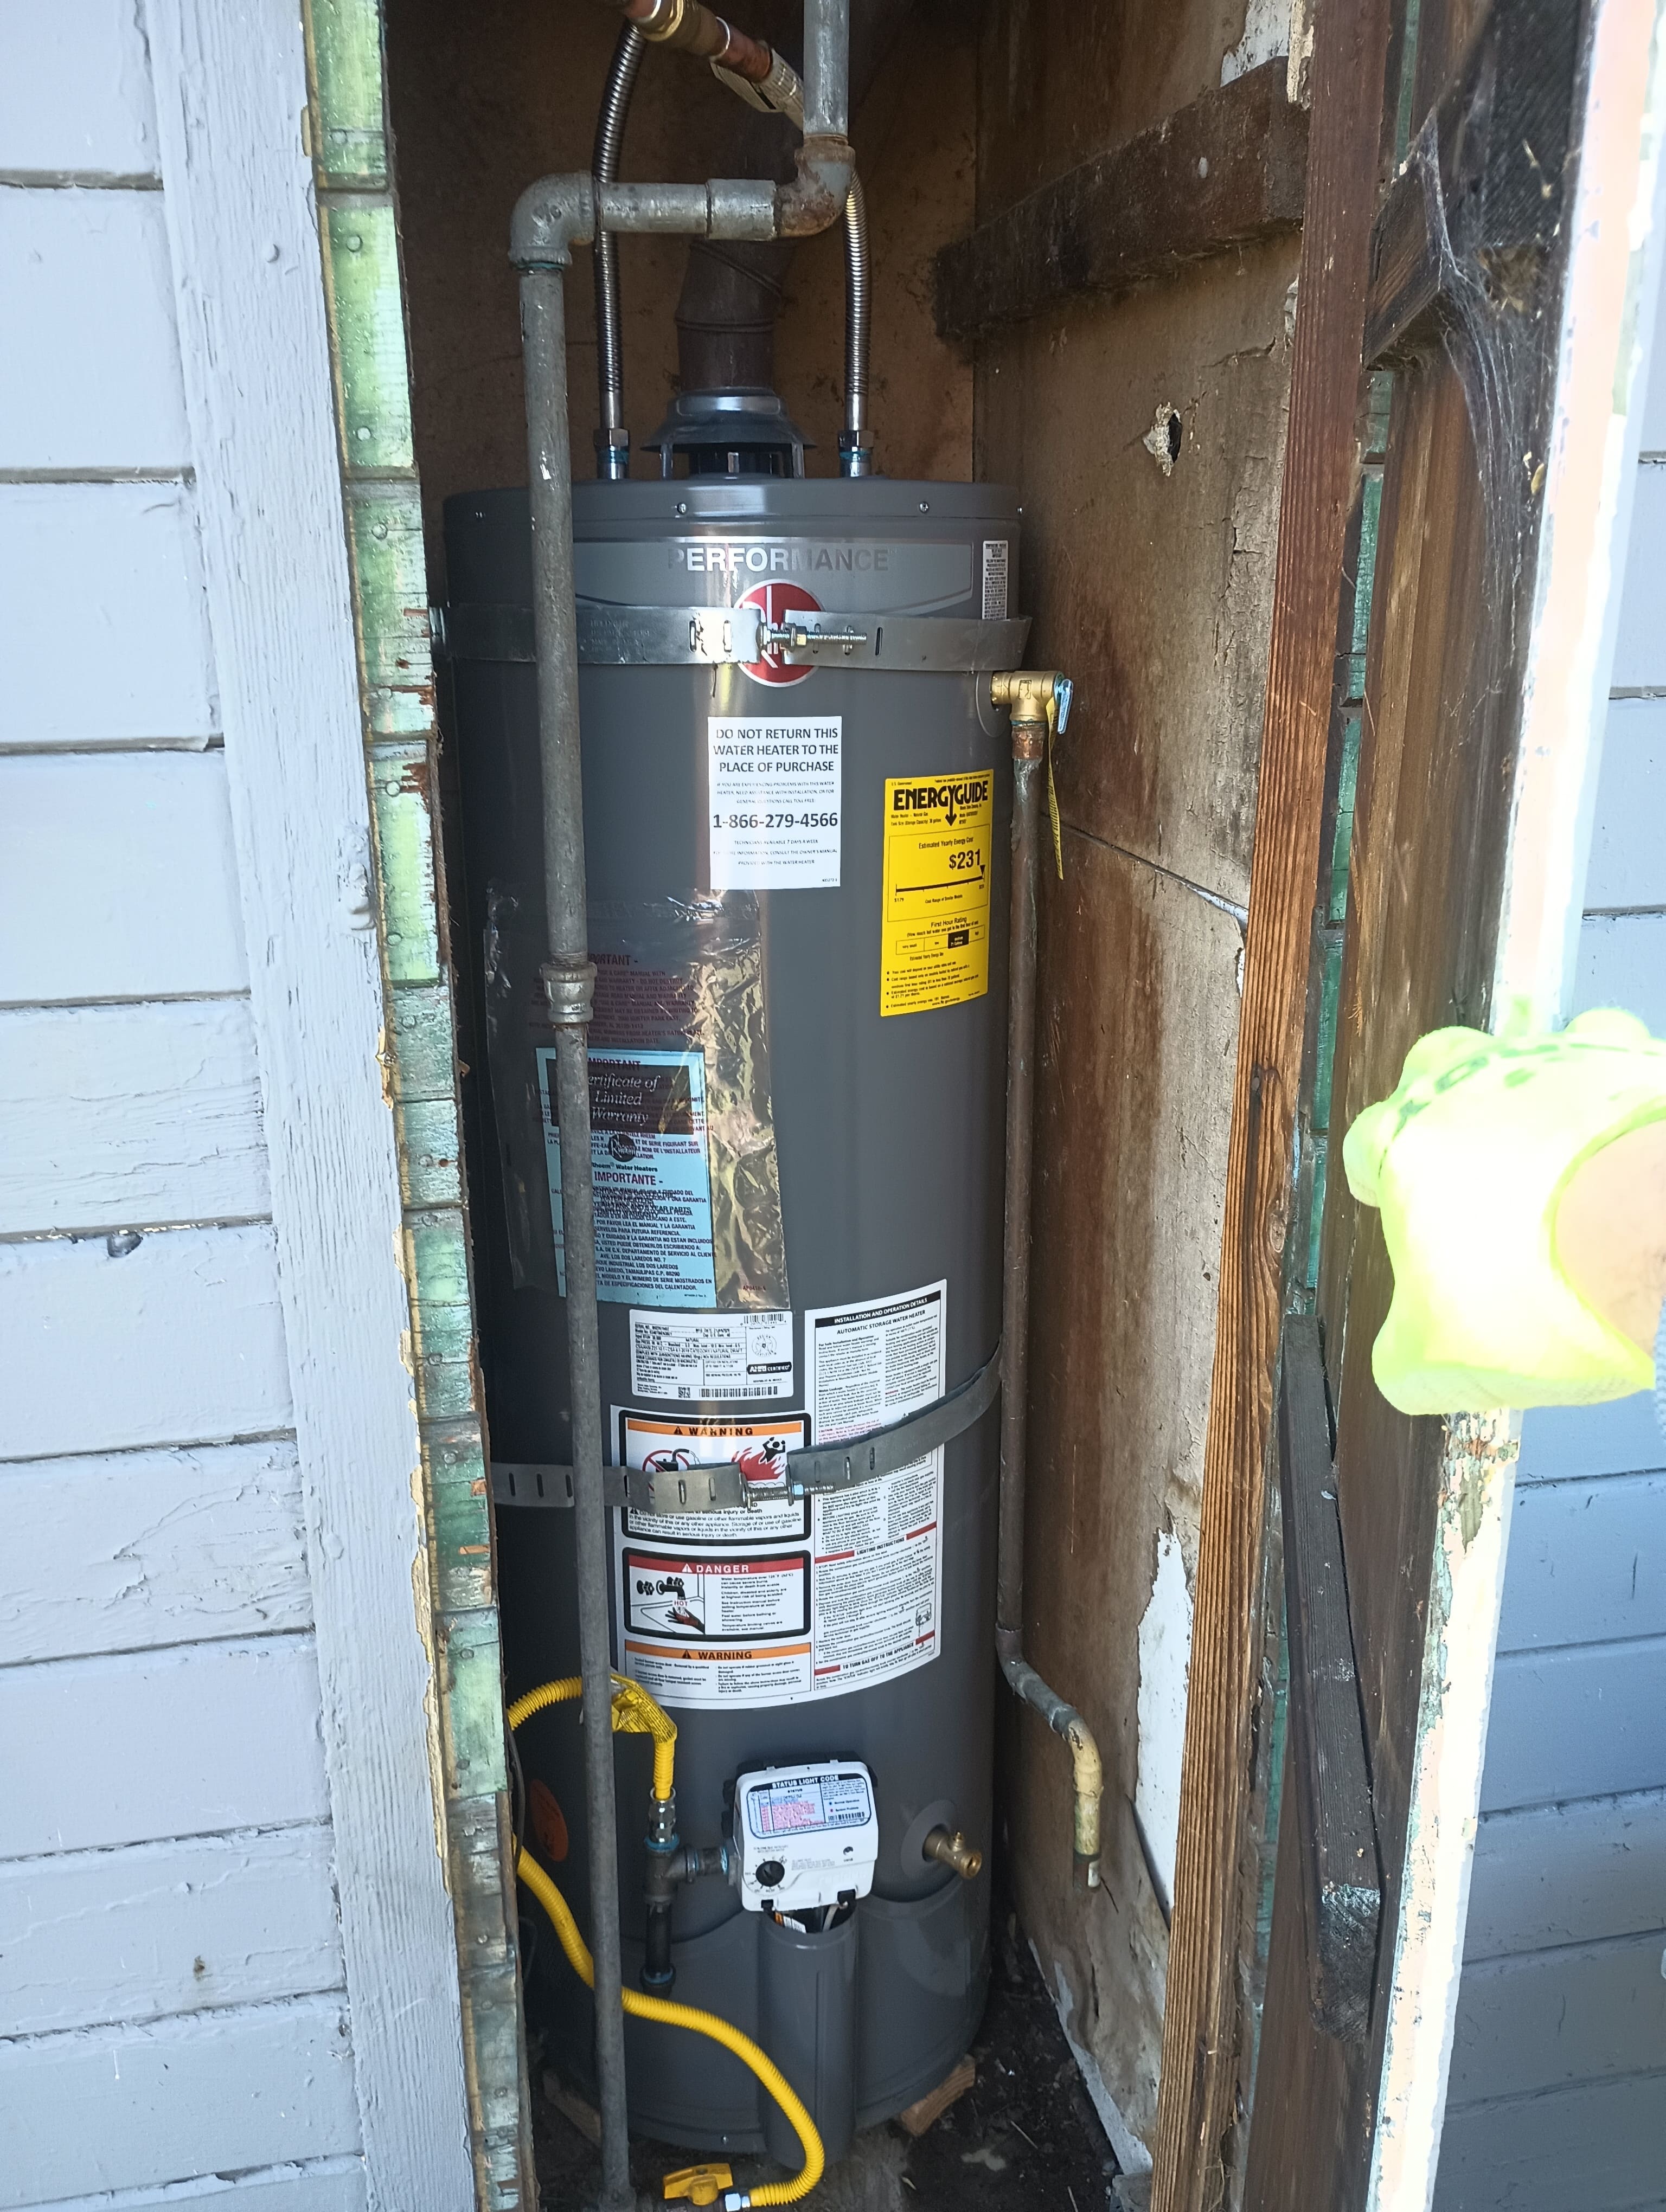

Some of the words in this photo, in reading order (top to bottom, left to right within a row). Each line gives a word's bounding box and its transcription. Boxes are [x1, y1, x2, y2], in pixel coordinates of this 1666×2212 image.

[668, 547, 888, 571] PERFORMANCE
[716, 729, 733, 738] DO
[738, 729, 762, 738] NOT
[766, 729, 811, 738] RETURN
[814, 728, 838, 738] THIS
[713, 745, 754, 755] WATER
[757, 745, 799, 755] HEATER
[802, 745, 816, 754] TO
[819, 744, 838, 754] THE
[720, 762, 754, 772] PLACE
[758, 762, 773, 772] OF
[776, 761, 834, 771] PURCHASE
[894, 781, 988, 811] ENERGYGUIDE
[713, 813, 838, 828] 1-866-279-4566
[949, 848, 981, 870] $231
[588, 1057, 640, 1070] MPORTANT
[588, 1073, 642, 1089] ertificate
[645, 1075, 661, 1092] of
[595, 1090, 642, 1105] Limited
[592, 1107, 649, 1126] Warranty
[594, 1171, 656, 1185] IMPORTANTE
[834, 1311, 871, 1324] INSTALLATION
[872, 1308, 883, 1316] AND
[883, 1303, 910, 1314] OPERATION
[911, 1298, 927, 1308] DETAILS
[837, 1324, 868, 1335] AUTOMATIC
[869, 1320, 892, 1329] STORAGE
[893, 1315, 908, 1323] WATER
[909, 1310, 925, 1319] HEATER
[689, 1427, 753, 1436] WARNING
[857, 1546, 875, 1555] LIGHTING
[877, 1537, 905, 1549] INSTRUCTIONS
[696, 1564, 749, 1573] DANGER
[894, 1642, 913, 1654] APPLIANCE
[697, 1651, 752, 1661] WARNING
[772, 1780, 797, 1789] STATUS
[799, 1777, 818, 1785] LIGHT
